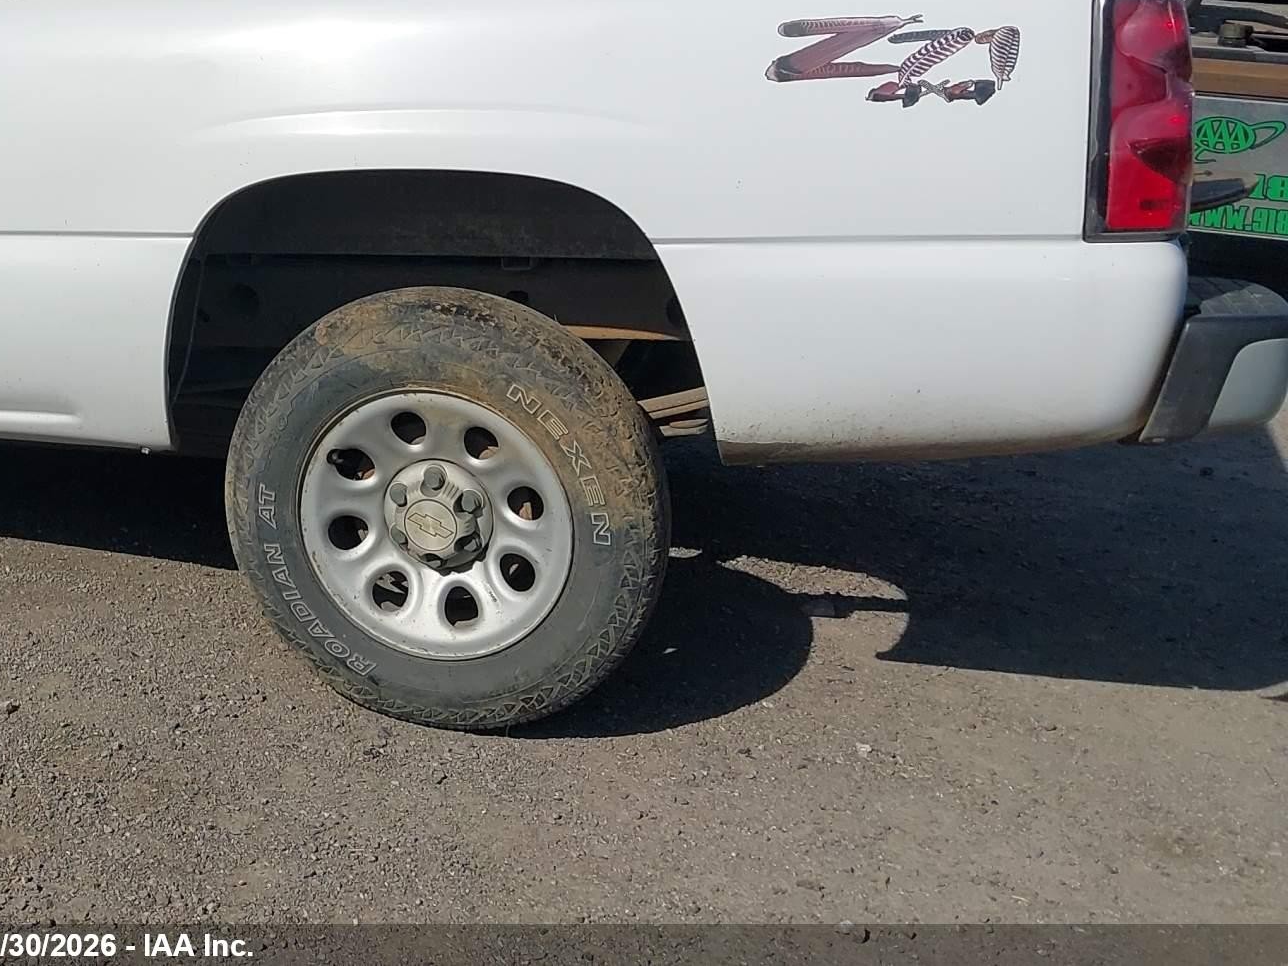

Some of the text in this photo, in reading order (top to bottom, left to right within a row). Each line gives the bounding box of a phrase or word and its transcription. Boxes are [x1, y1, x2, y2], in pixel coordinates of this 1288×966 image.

[1199, 120, 1248, 150] AAA
[506, 384, 612, 546] NEXEN
[258, 484, 377, 676] ROADIAN AT
